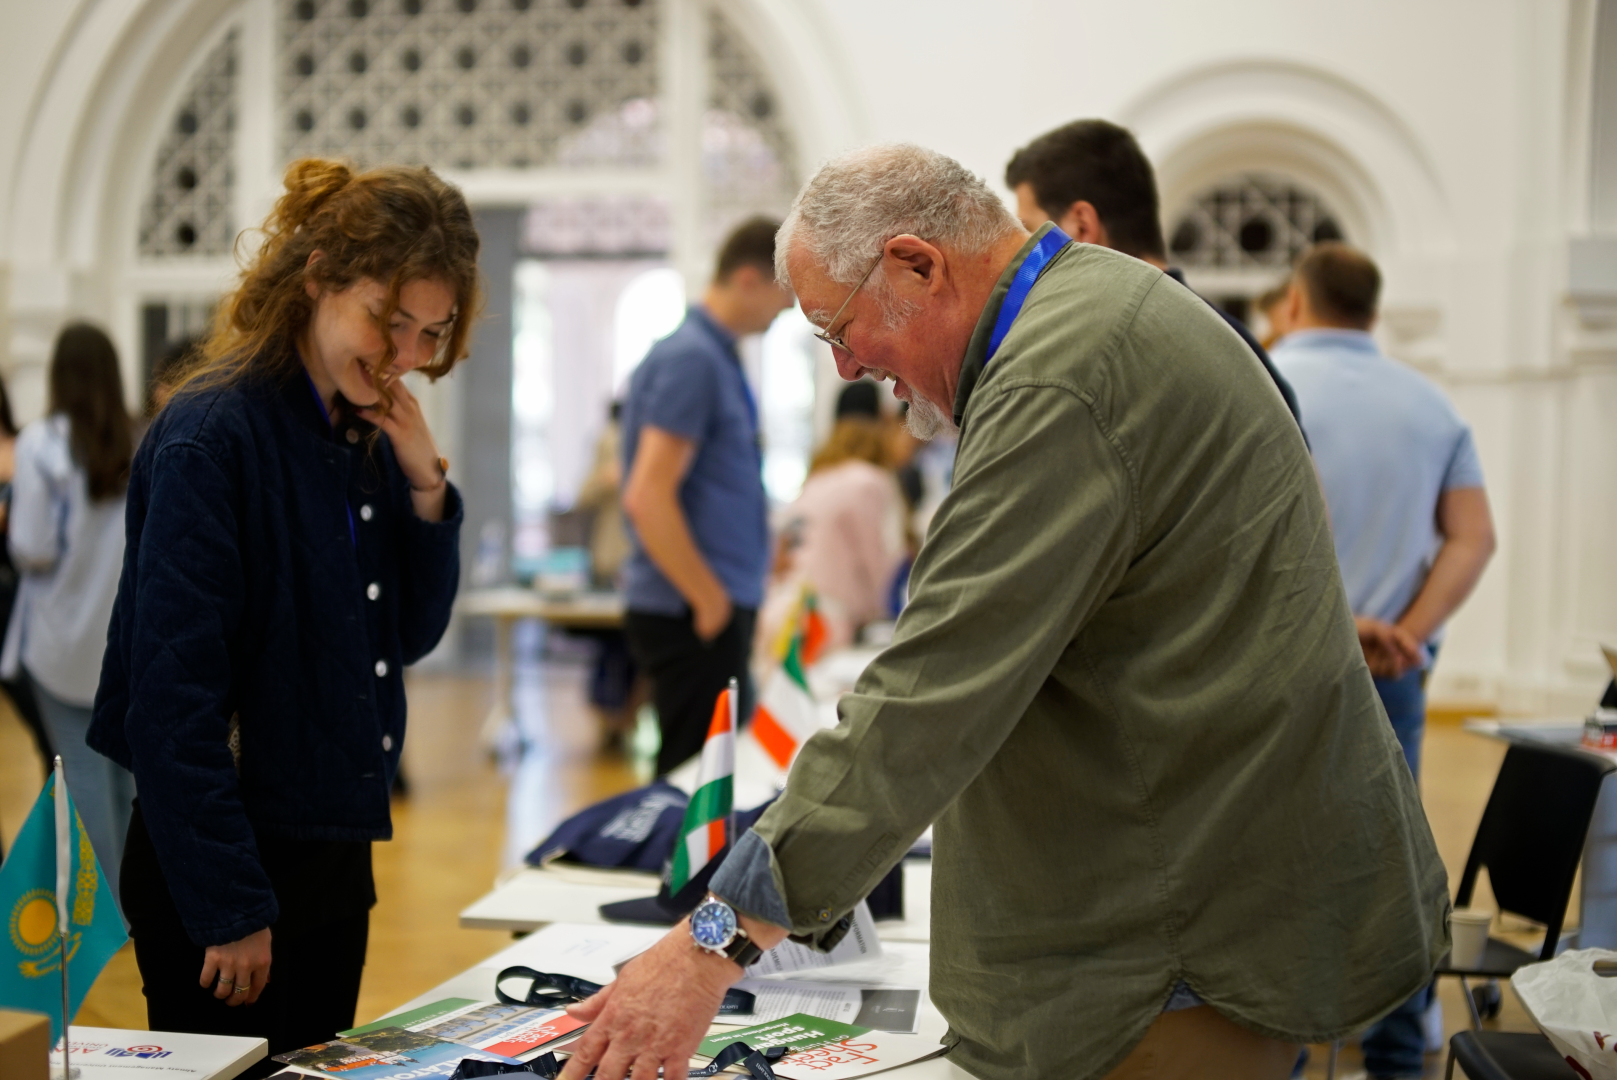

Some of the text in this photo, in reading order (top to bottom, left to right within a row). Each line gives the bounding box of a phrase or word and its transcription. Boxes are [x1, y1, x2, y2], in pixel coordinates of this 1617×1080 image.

[851, 917, 867, 954] NFORMATION
[754, 1026, 805, 1042] sport
[795, 1052, 880, 1071] Fact
